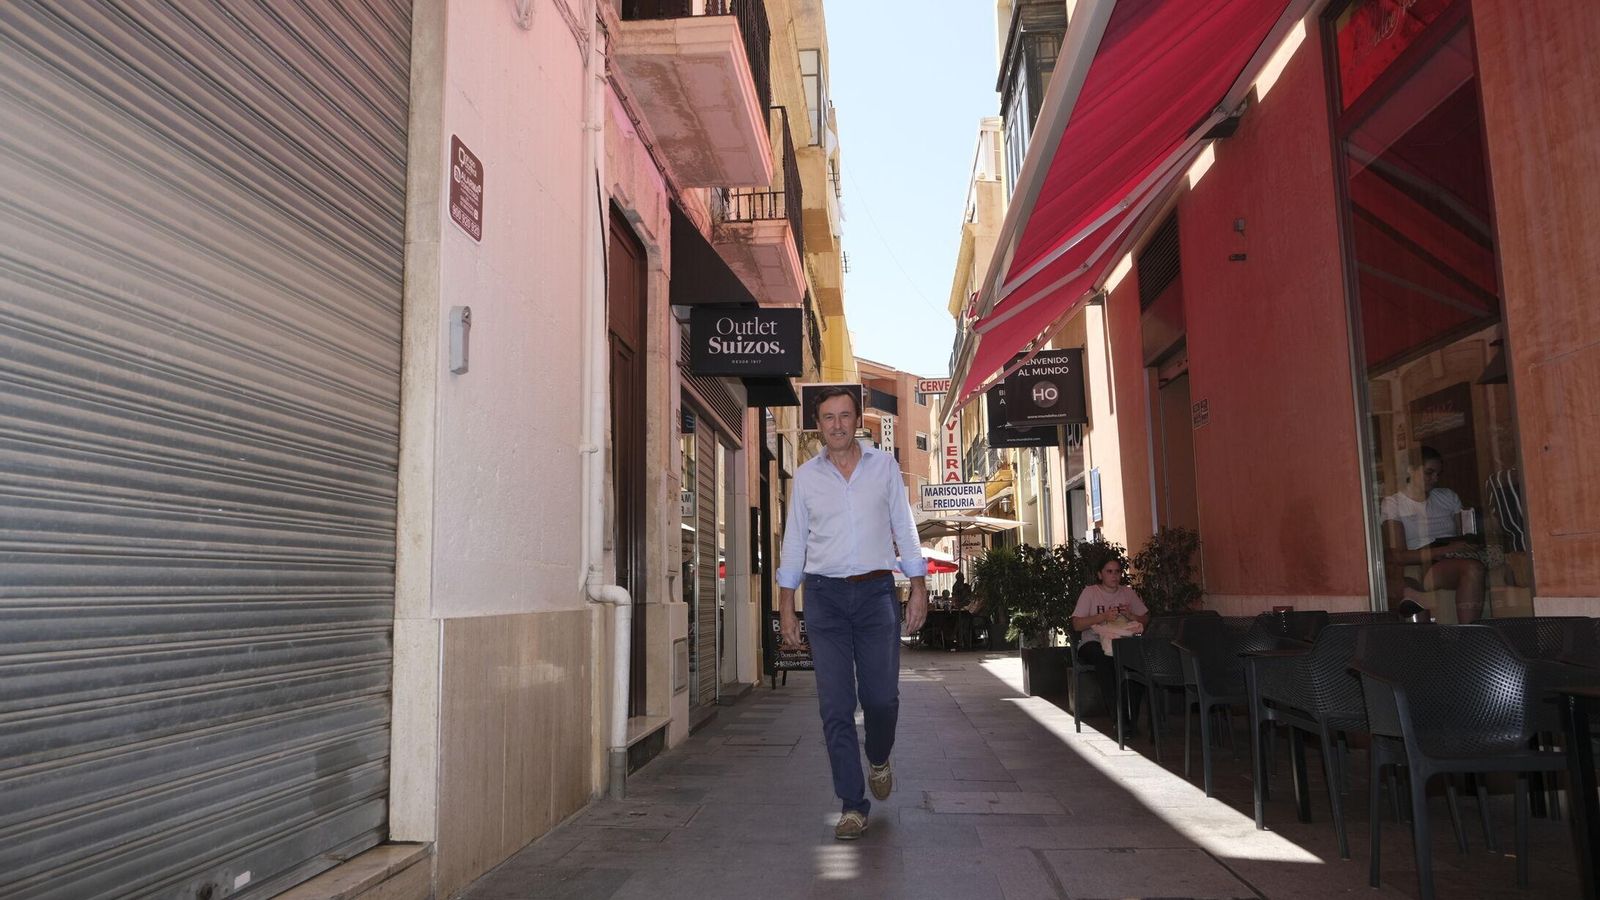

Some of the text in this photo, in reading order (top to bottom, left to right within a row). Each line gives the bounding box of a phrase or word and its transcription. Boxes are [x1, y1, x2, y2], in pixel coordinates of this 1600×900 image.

[716, 317, 778, 335] Outlet
[708, 336, 785, 354] Suizos.
[1017, 357, 1068, 366] ENVENIDO
[1018, 366, 1069, 377] AL MUNDO
[920, 380, 950, 392] CERVE
[1033, 387, 1058, 401] HO
[882, 417, 892, 442] MODA
[944, 409, 961, 482] VIERA
[924, 485, 983, 497] MARISQUERIA
[933, 498, 975, 509] FREIDURIA
